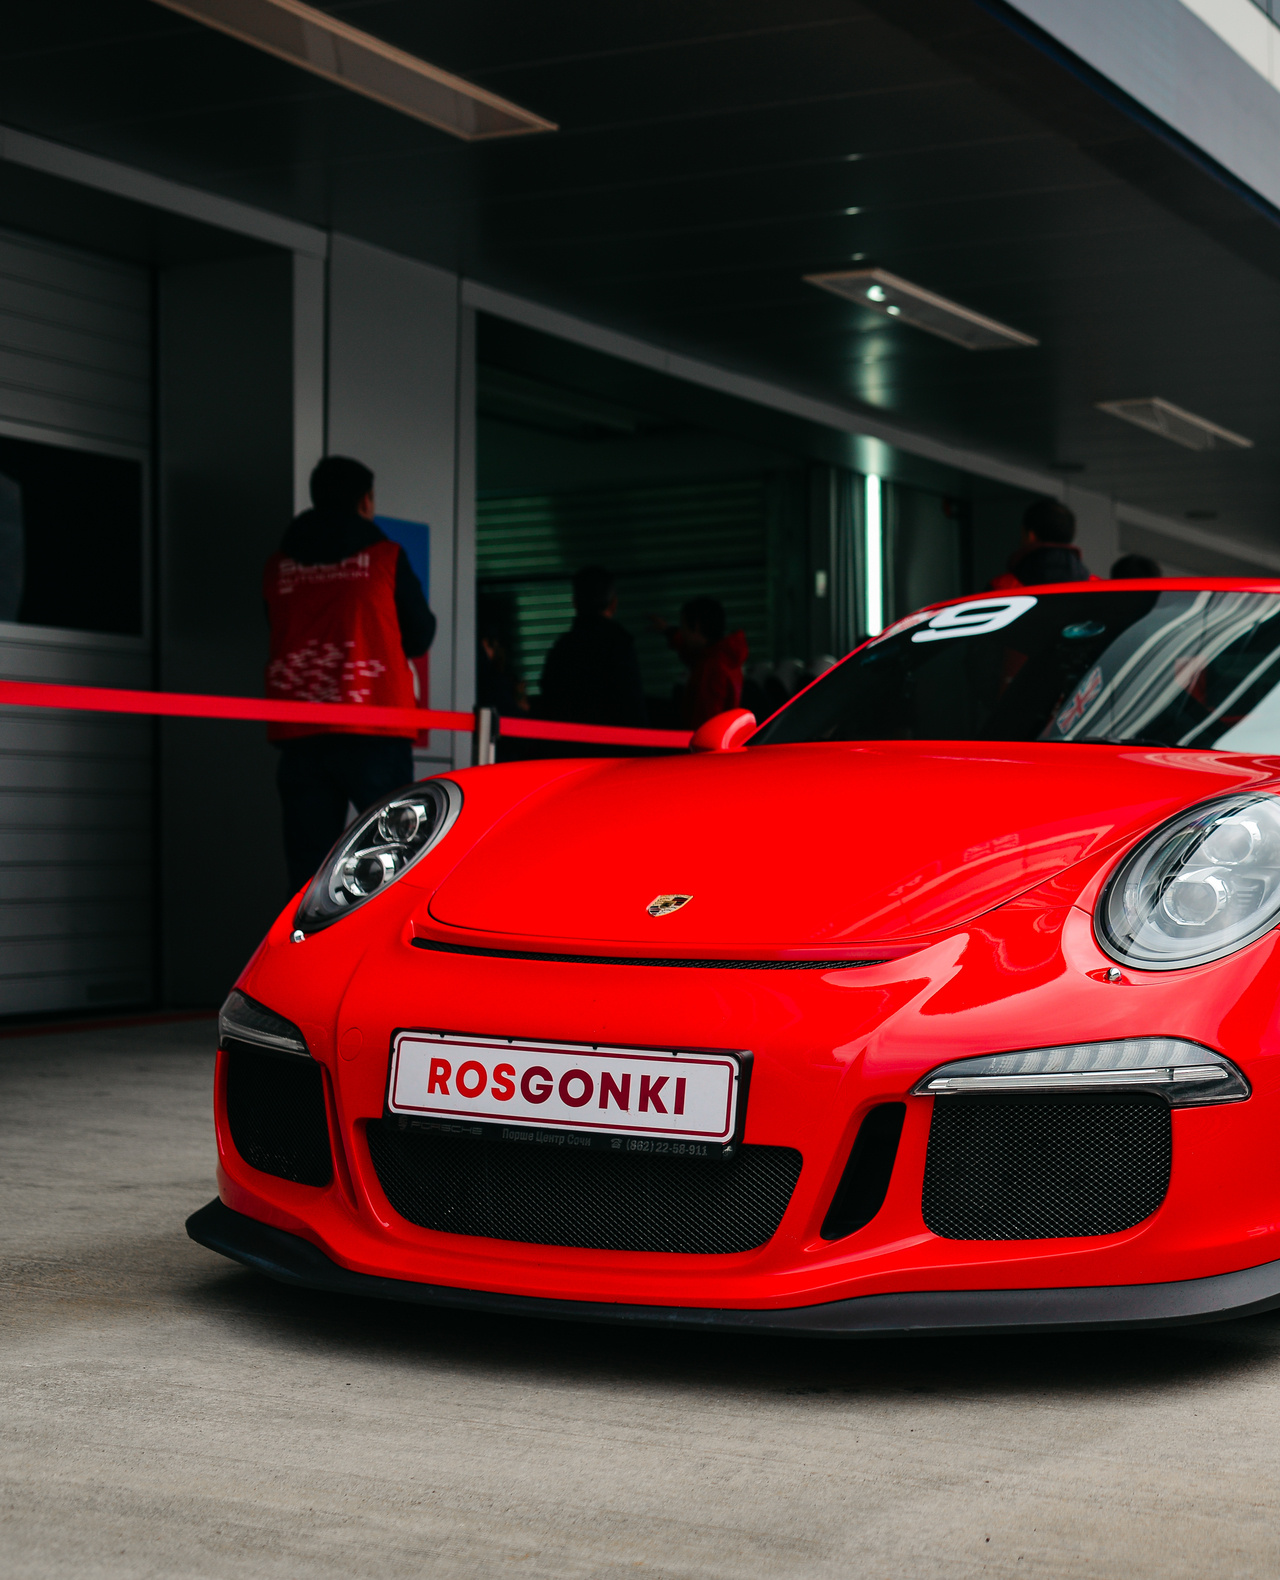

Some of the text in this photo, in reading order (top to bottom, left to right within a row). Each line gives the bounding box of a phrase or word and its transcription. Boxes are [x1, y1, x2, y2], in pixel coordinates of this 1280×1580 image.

[911, 595, 1038, 643] 9
[427, 1057, 687, 1116] ROSGONKI
[410, 1120, 483, 1135] PORSCHE
[502, 1128, 592, 1146] Порше Центр Сочи
